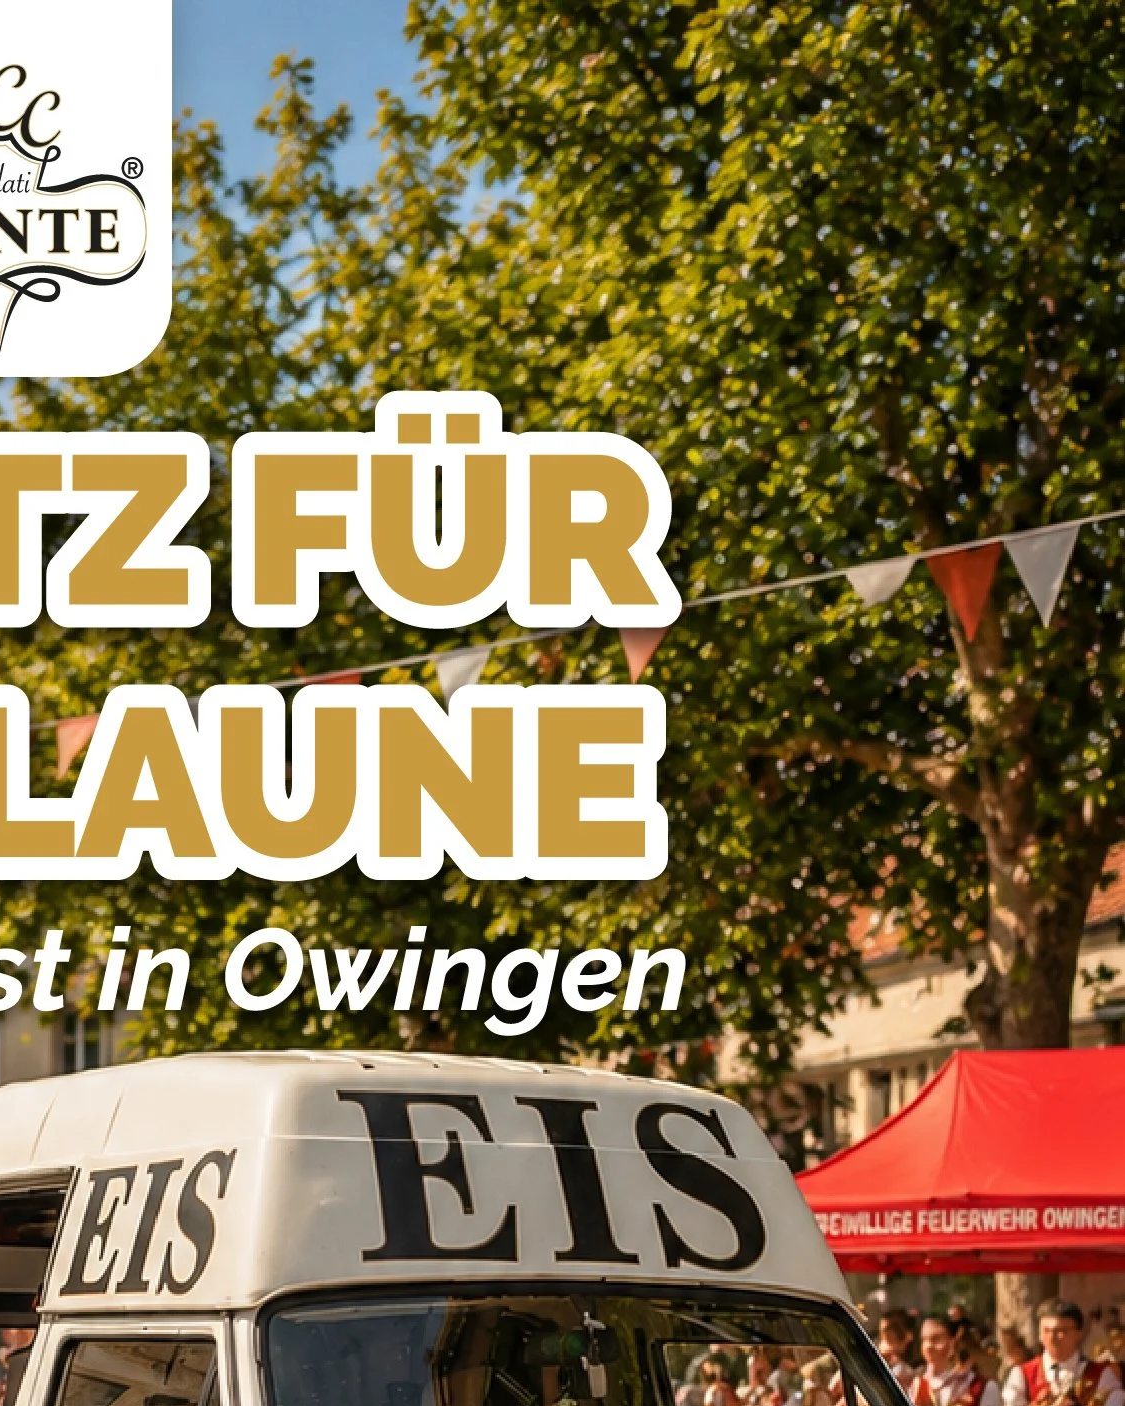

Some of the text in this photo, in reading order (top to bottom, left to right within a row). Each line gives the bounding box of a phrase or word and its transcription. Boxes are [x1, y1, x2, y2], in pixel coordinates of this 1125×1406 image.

[59, 1148, 237, 1297] EIS
[337, 1089, 767, 1272] EIS
[917, 1206, 1038, 1234] FEUERWEHR
